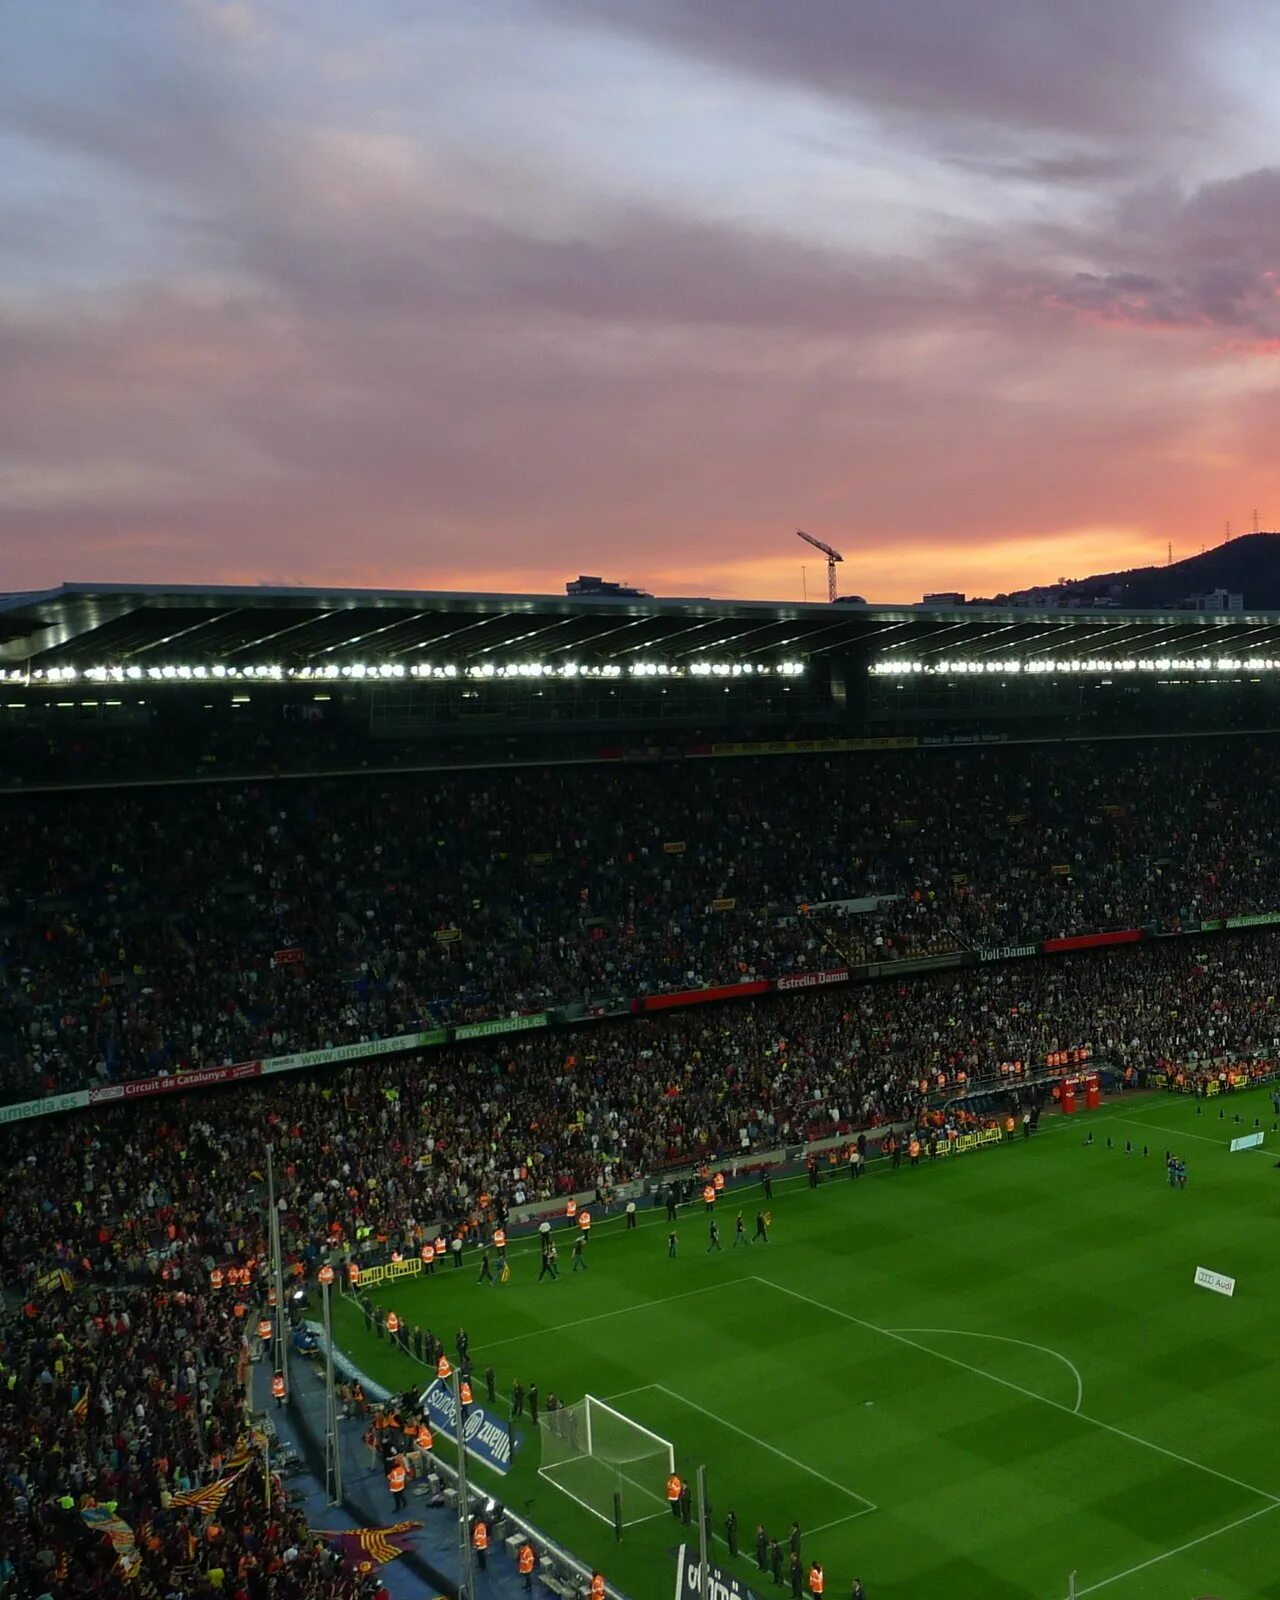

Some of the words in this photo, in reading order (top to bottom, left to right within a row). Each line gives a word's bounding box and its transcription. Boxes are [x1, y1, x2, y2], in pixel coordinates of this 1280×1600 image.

[980, 945, 1036, 961] Voll-Damm
[778, 974, 816, 990] Estrella
[818, 971, 849, 984] Damm
[301, 1038, 407, 1065] www.umedia.es
[126, 1080, 159, 1095] Circuit
[162, 1076, 175, 1088] de
[177, 1070, 227, 1087] Catalunya
[1215, 1279, 1232, 1291] Audi
